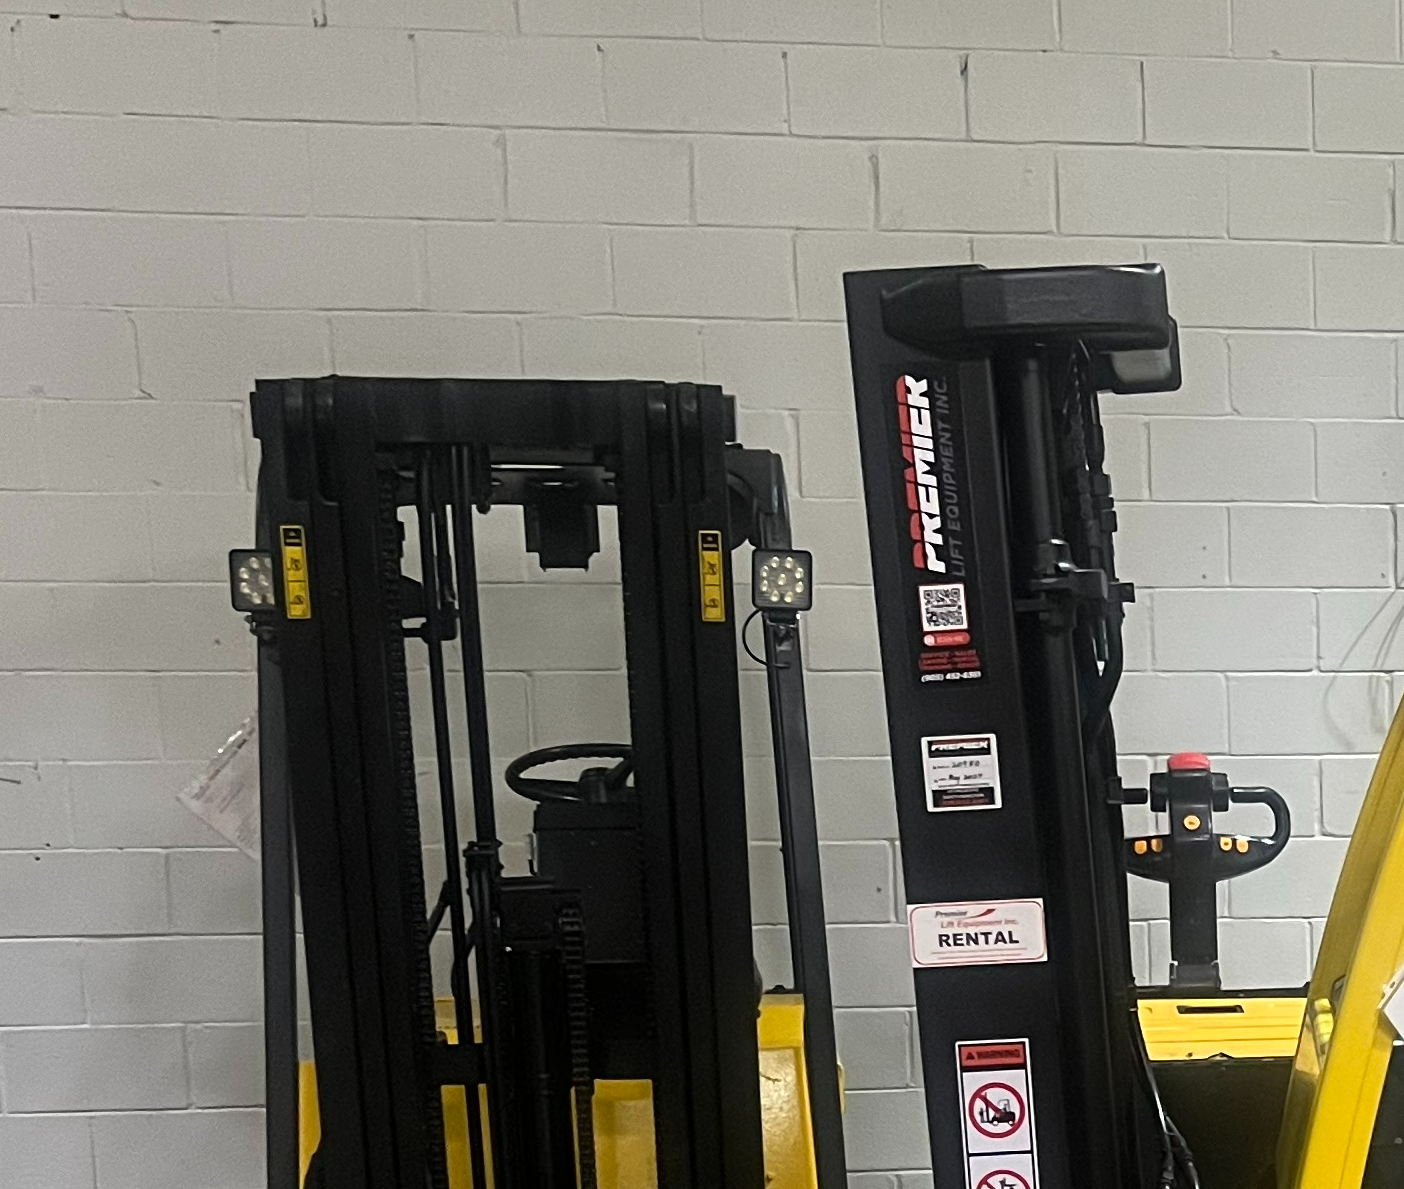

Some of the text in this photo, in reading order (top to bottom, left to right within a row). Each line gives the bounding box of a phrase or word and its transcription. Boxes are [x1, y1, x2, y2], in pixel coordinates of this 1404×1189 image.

[895, 374, 946, 574] PREMIER
[938, 421, 961, 532] EQUIPMENT
[947, 536, 966, 577] LIFT
[938, 930, 1020, 948] RENTAL
